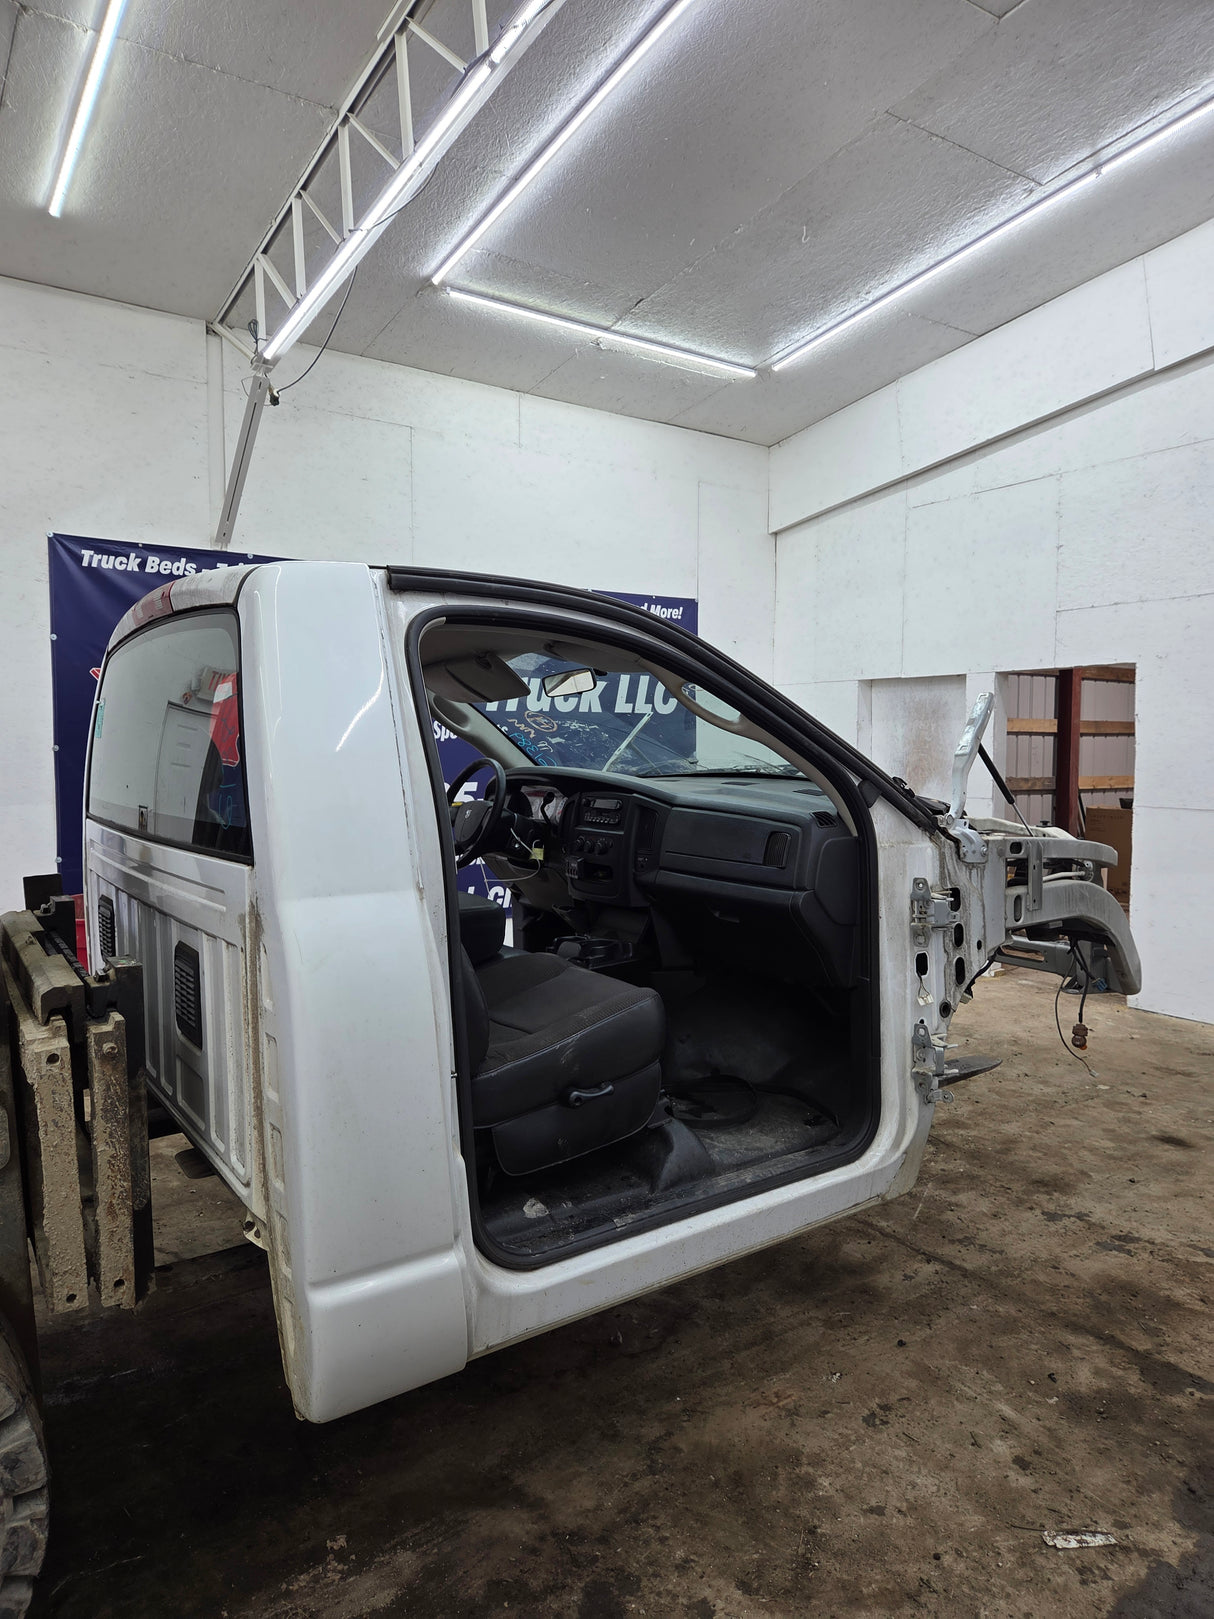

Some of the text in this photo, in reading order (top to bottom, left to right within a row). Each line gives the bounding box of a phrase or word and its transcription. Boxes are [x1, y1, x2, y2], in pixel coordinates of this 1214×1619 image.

[80, 549, 141, 572] Truck
[145, 557, 197, 576] Beds
[650, 604, 683, 620] More!
[485, 674, 679, 715] uck LLC
